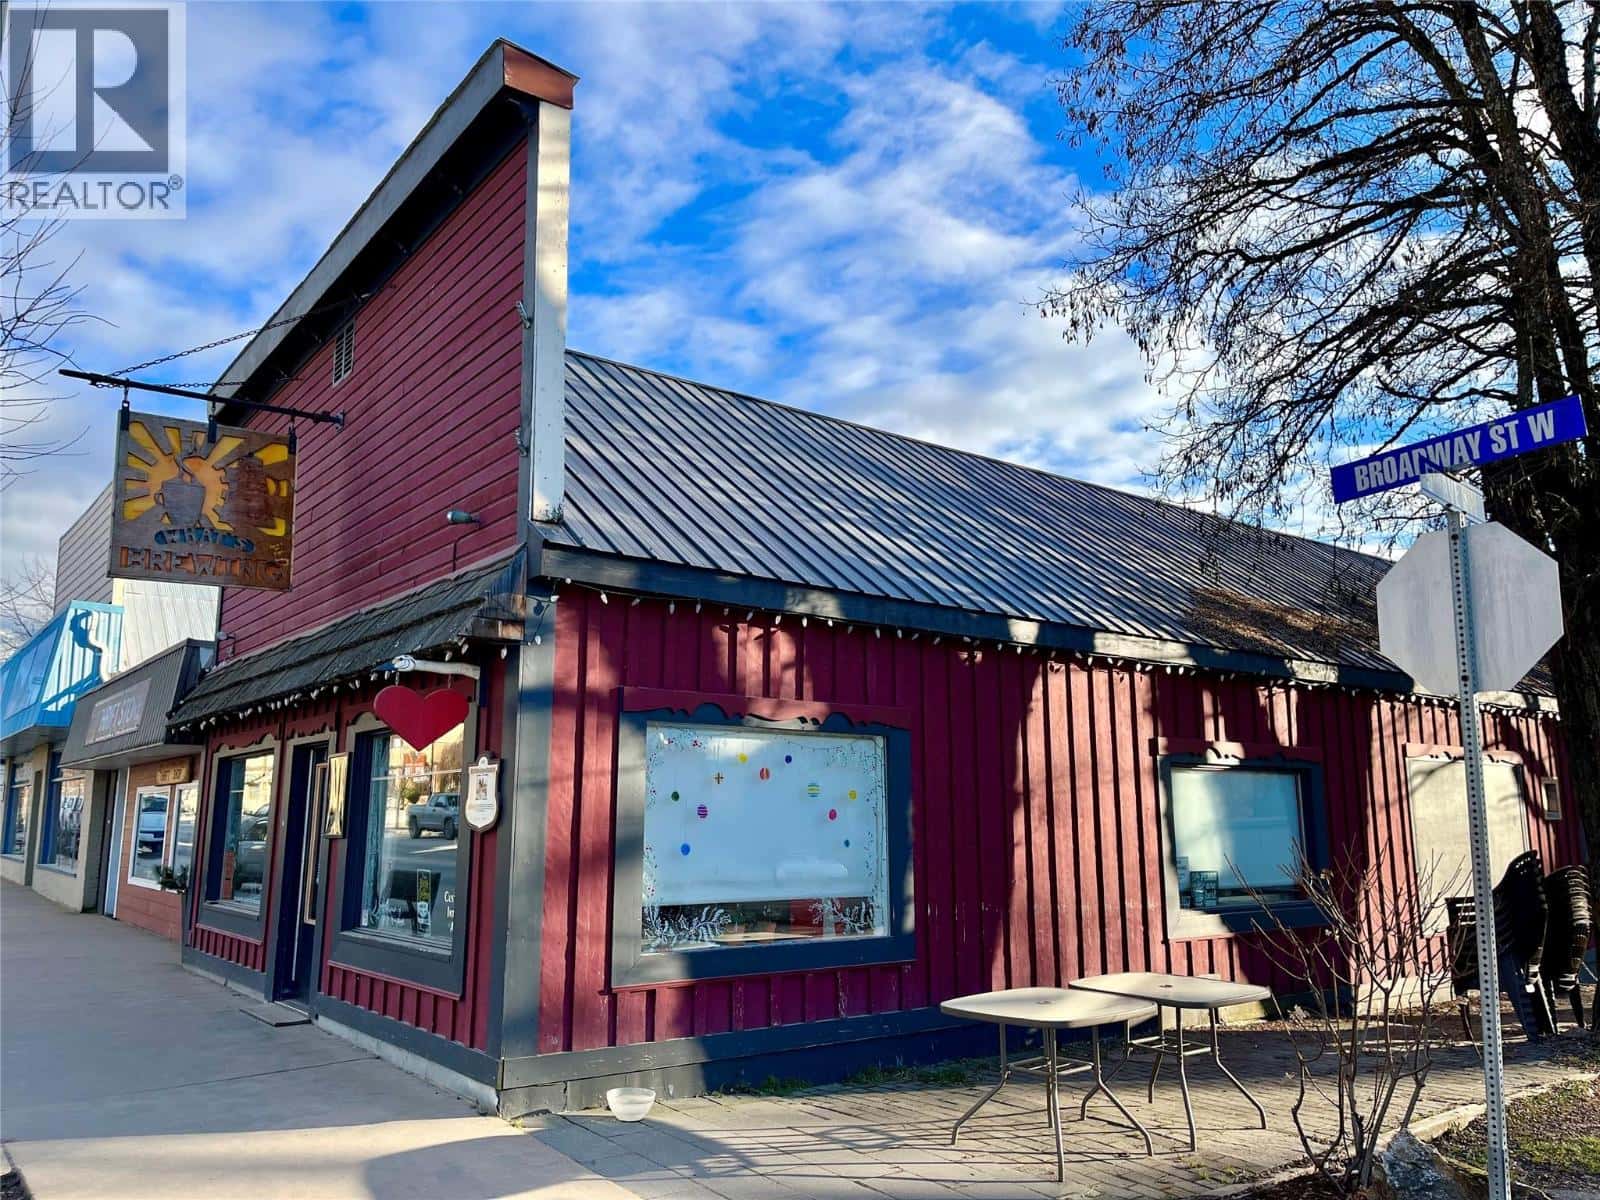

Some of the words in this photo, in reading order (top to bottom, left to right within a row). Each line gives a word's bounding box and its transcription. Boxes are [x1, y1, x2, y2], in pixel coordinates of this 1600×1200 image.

[1354, 430, 1481, 492] BROADWAY
[1488, 419, 1519, 454] ST
[1527, 409, 1556, 444] W
[125, 547, 285, 581] BREWING
